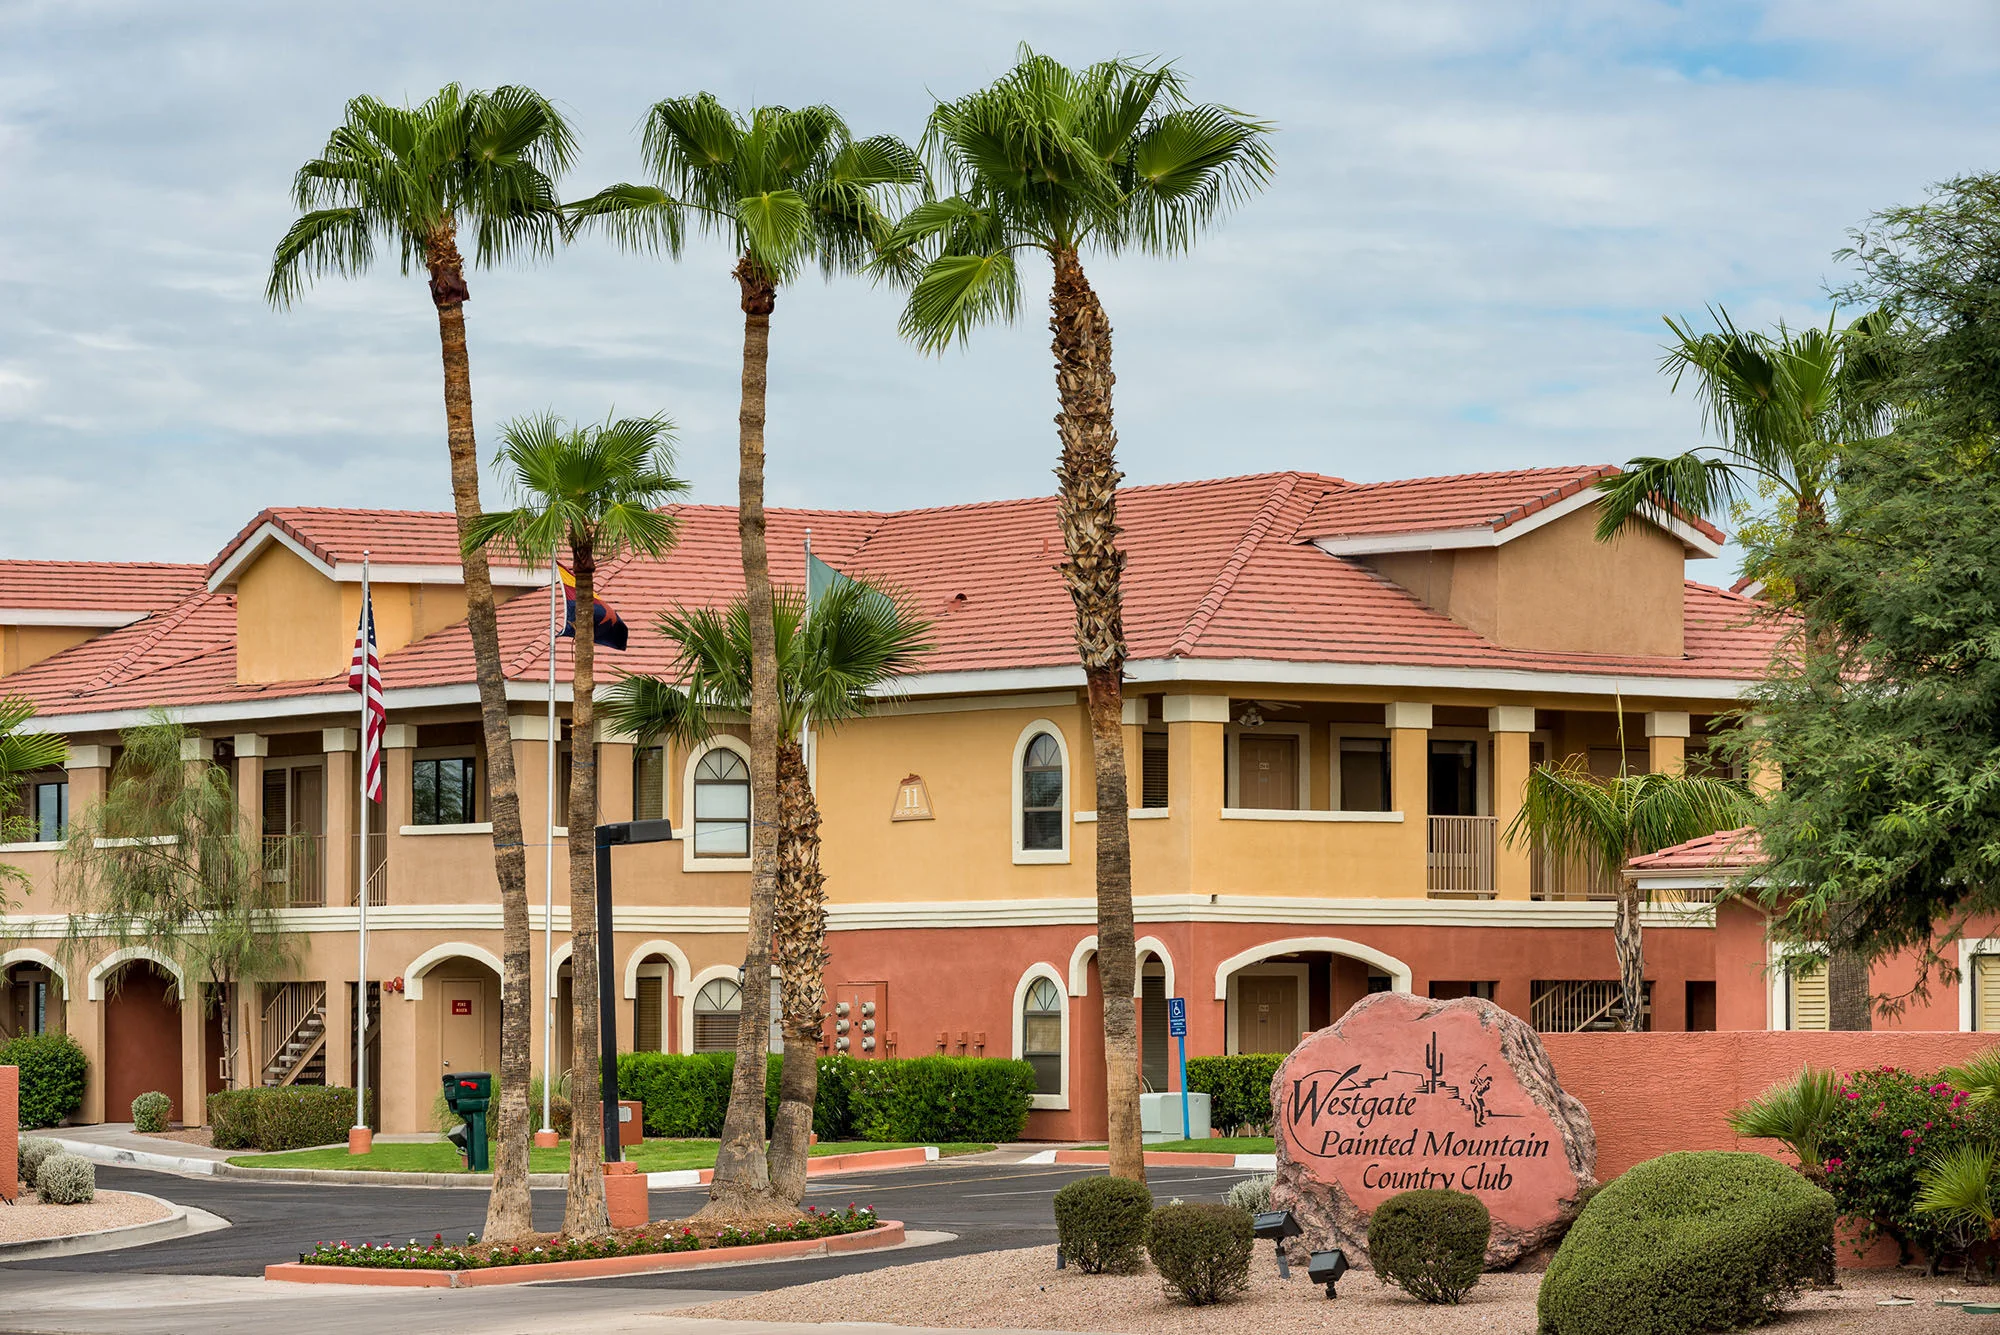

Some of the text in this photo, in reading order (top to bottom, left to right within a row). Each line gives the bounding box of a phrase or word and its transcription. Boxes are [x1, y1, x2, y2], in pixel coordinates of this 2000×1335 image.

[903, 788, 919, 808] 11
[1293, 1064, 1417, 1128] Westgate
[1320, 1129, 1550, 1157] Painted Mountain
[1363, 1162, 1513, 1191] Country Club
